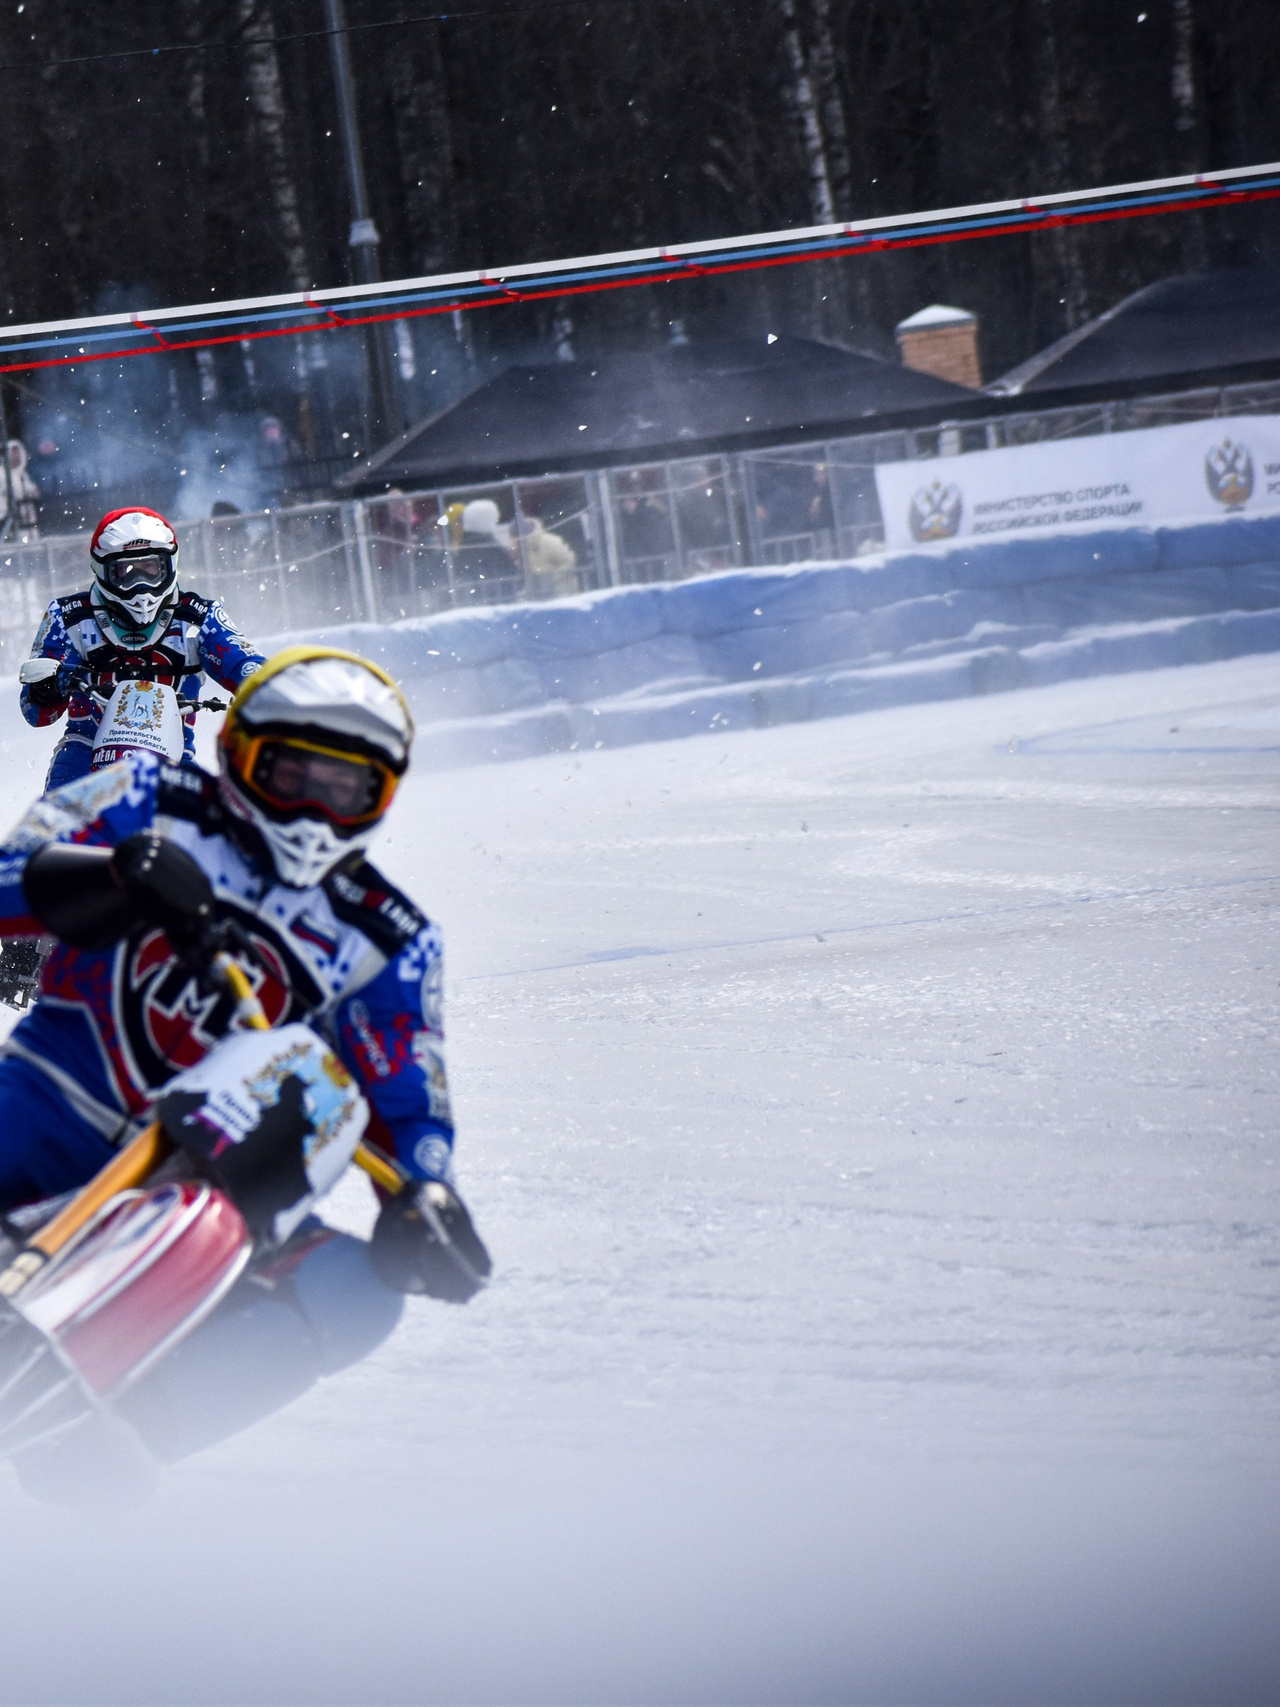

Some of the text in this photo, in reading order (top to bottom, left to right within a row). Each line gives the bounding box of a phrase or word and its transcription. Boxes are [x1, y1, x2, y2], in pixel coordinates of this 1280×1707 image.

[973, 483, 1131, 516] МИНИСТЕРСТВО СПОРТА
[972, 501, 1143, 536] РОССИЙСКОЙ ФЕДЕРАЦИИ
[61, 601, 83, 614] MEGA
[189, 598, 209, 614] LADA
[109, 729, 162, 743] Правительство
[102, 737, 167, 753] Самарской области
